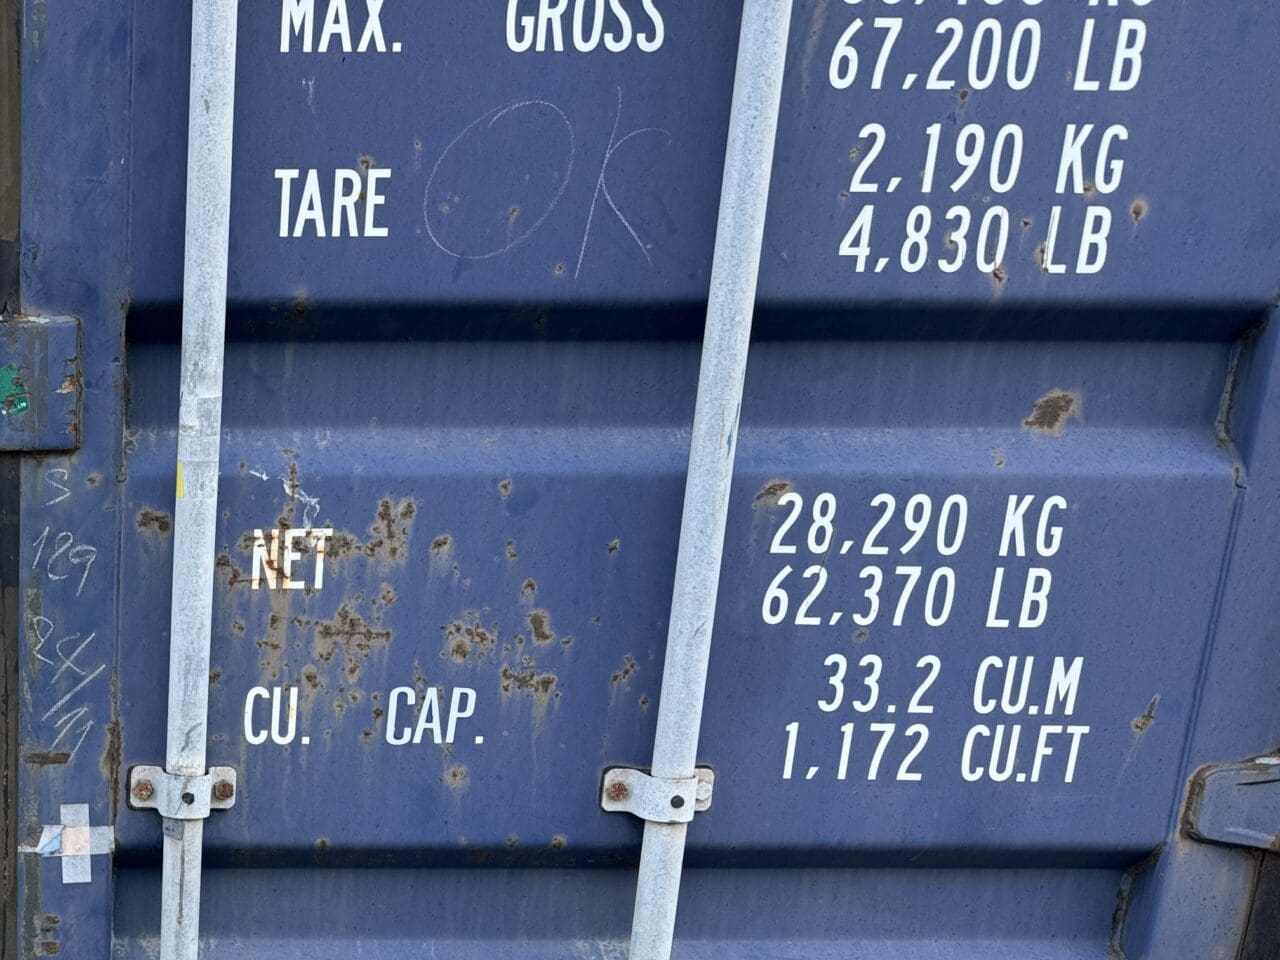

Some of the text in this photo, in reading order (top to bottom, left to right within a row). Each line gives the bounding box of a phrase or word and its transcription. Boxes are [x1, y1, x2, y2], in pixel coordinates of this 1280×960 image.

[280, 0, 665, 53] MAX. GROSS
[829, 17, 1147, 91] 67,200 LB
[849, 122, 1129, 194] 2,190 KG
[274, 168, 392, 238] TARE
[838, 204, 1112, 274] 4,830 LB
[769, 492, 1068, 557] 28,290 KG
[251, 528, 334, 590] NET
[762, 564, 1052, 628] 62,370 LB
[243, 686, 484, 746] CU. CAP.
[817, 653, 1085, 716] 33.2 CU.M
[782, 721, 1091, 783] 1,172 CU.FT
